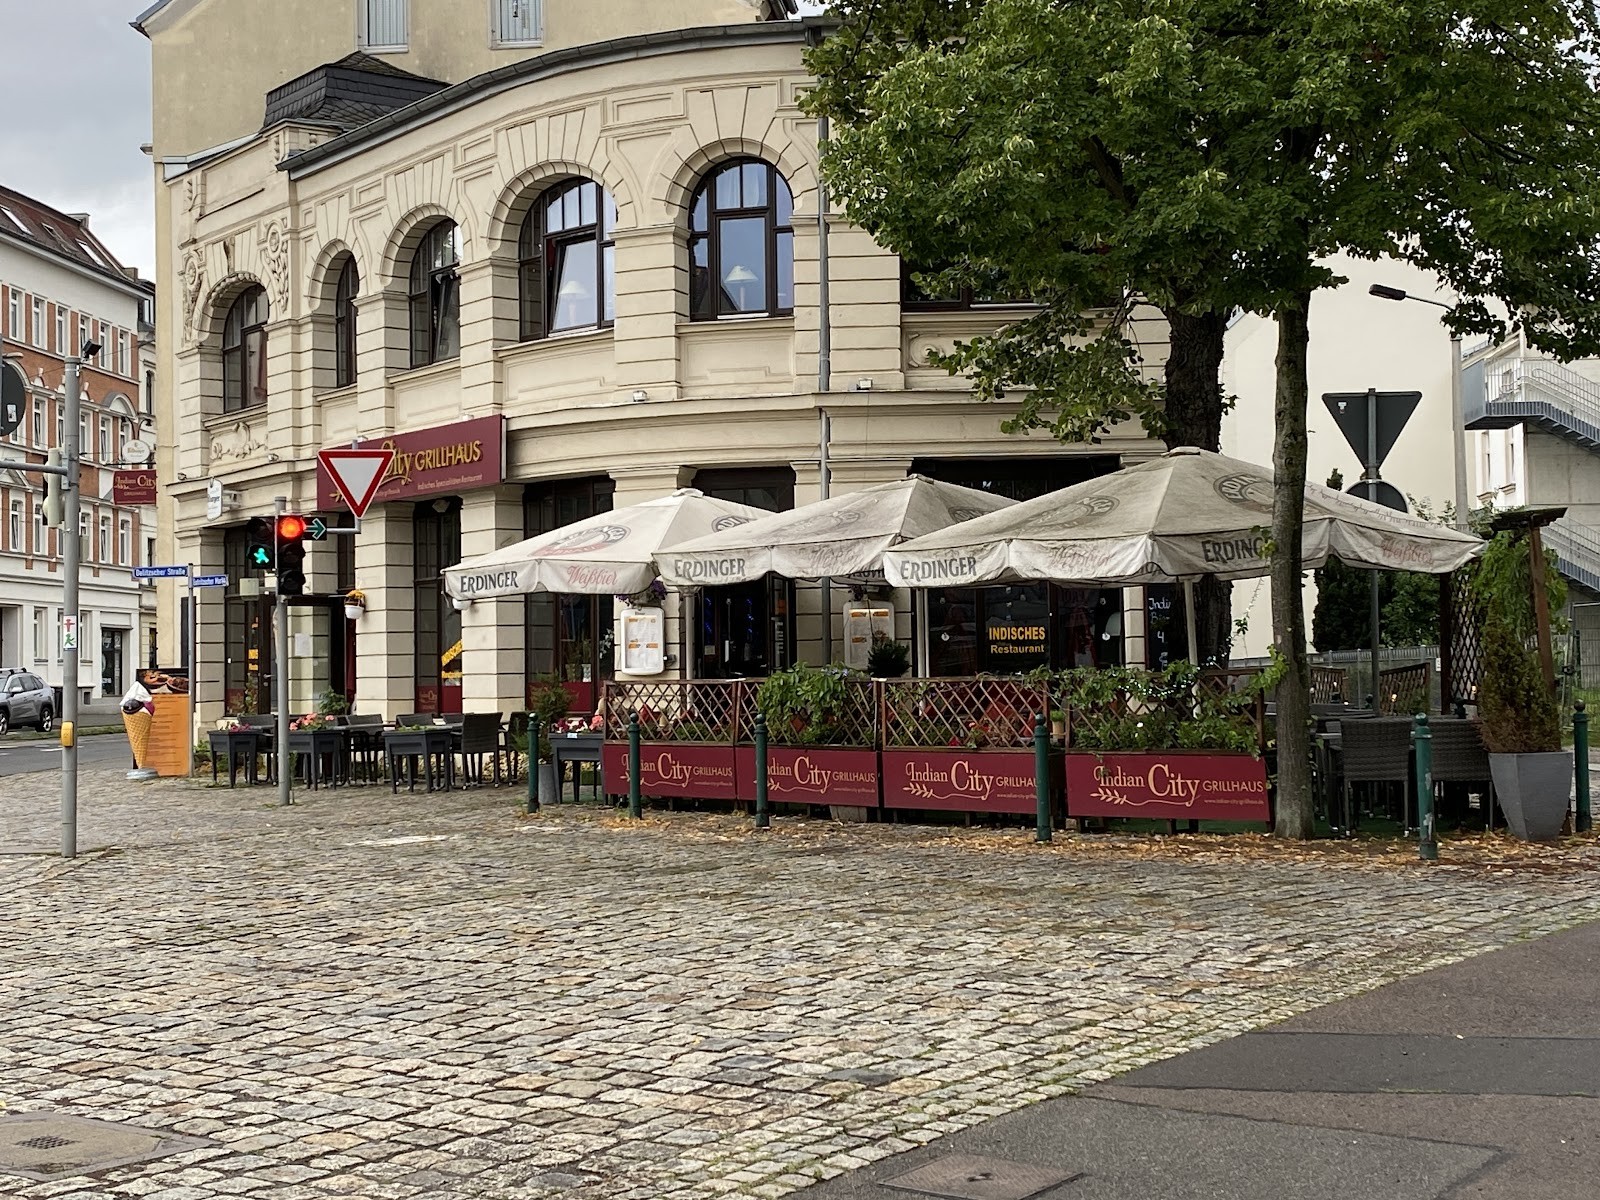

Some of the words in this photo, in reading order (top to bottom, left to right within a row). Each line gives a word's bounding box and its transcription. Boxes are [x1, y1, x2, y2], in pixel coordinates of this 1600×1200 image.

[414, 441, 482, 471] GRILLHAUS
[137, 475, 156, 490] City
[1201, 536, 1264, 564] ERDING
[167, 567, 186, 576] Straße
[566, 565, 619, 588] Weißbier
[674, 558, 746, 578] ERDINGER
[900, 556, 977, 582] ERDINGER
[460, 571, 519, 593] ERDINGER
[988, 626, 1046, 641] INDISCHES
[990, 644, 1045, 654] Restaurant
[621, 753, 656, 772] Iian
[657, 752, 692, 788] City
[693, 766, 733, 777] GRILLHAUS
[794, 756, 832, 794] City
[832, 771, 876, 783] GRILLHAUS
[905, 761, 948, 782] Indian
[950, 760, 994, 800] City
[995, 776, 1038, 788] GRILLHAU
[1093, 765, 1145, 788] Indian
[1147, 763, 1201, 807] City
[1202, 780, 1264, 793] GRILLHAUS
